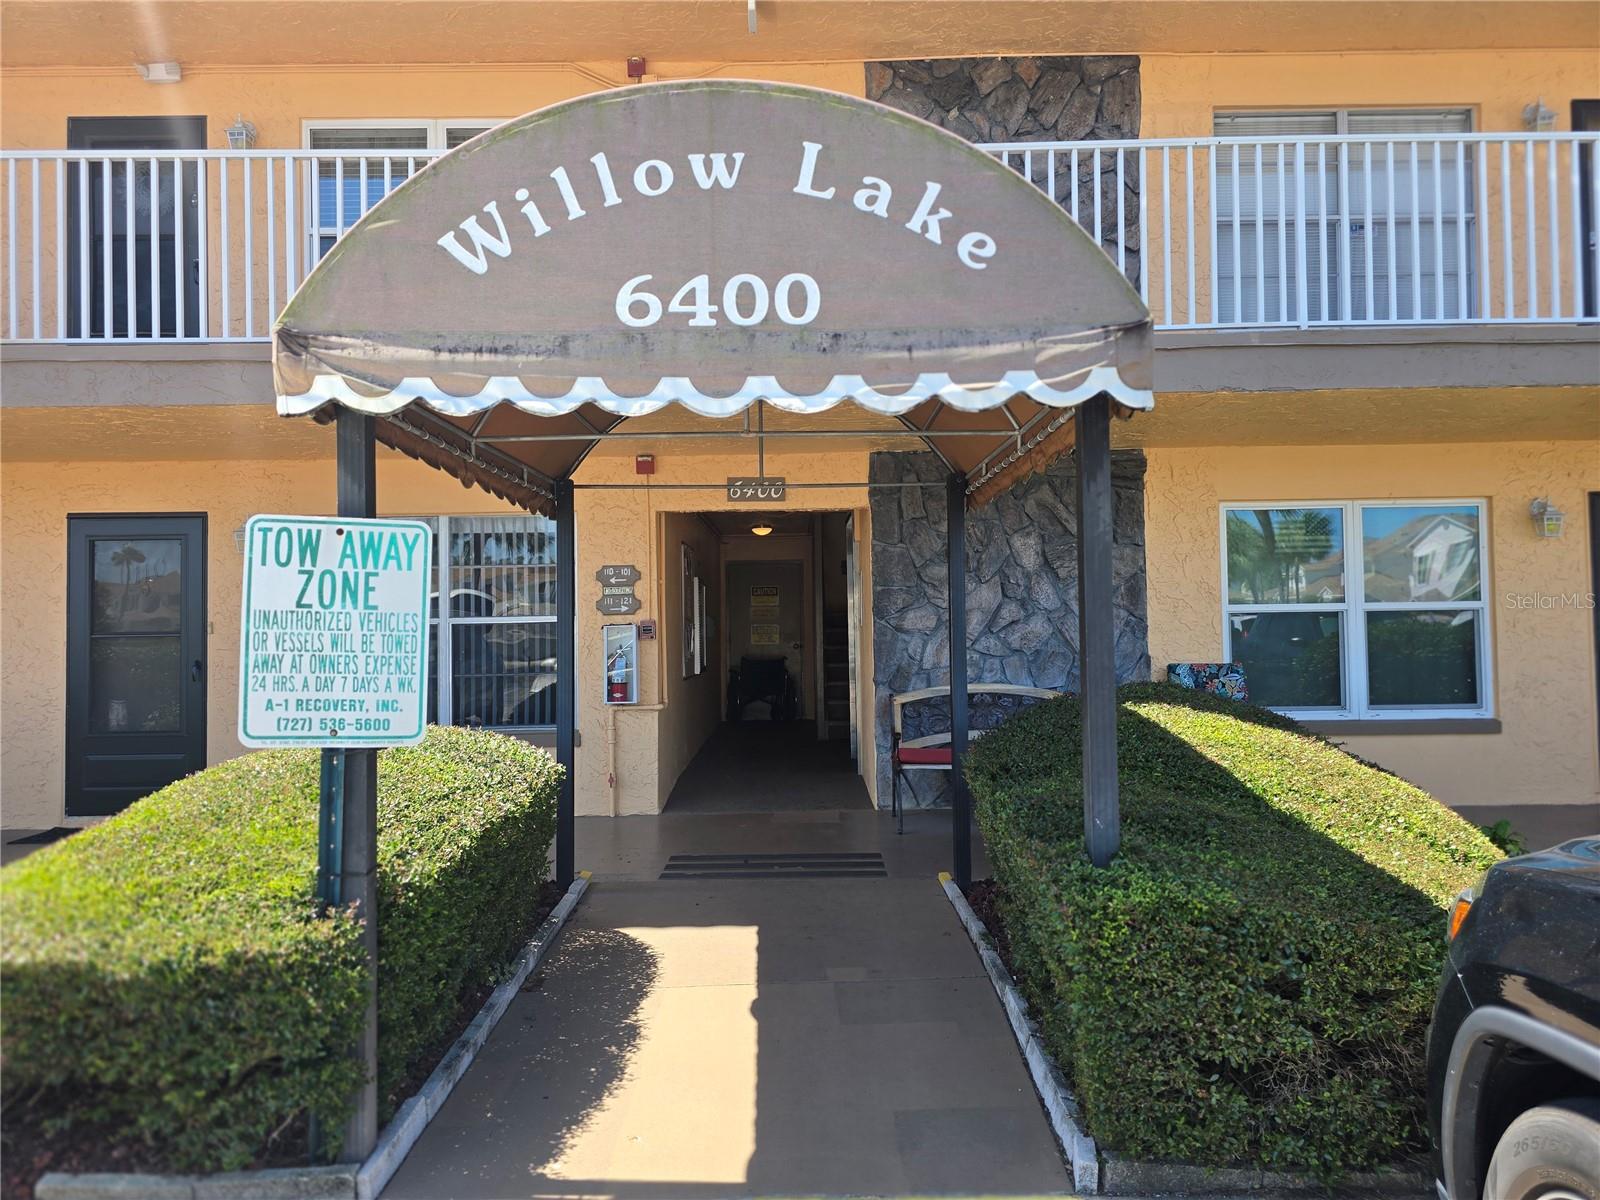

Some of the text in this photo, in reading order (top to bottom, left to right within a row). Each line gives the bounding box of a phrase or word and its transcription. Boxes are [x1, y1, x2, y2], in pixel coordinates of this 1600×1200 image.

[436, 141, 997, 275] Willow Lake
[614, 272, 822, 328] 6400
[730, 481, 783, 498] 6400
[257, 527, 421, 571] TOW AWAY
[296, 569, 380, 610] ZONE
[253, 609, 419, 633] UNAUTHORIZED VEHICLES
[253, 631, 418, 654] OR VESSELS WILL BE TOWED
[252, 653, 417, 676] AWAY AT OWNERS EXPENSE
[251, 675, 417, 693] 24 HRS. A DAY 7 DAYS A WK.
[265, 698, 403, 713] A-1 RECOVERY, INC.
[276, 717, 391, 732] (727) 536-5600
